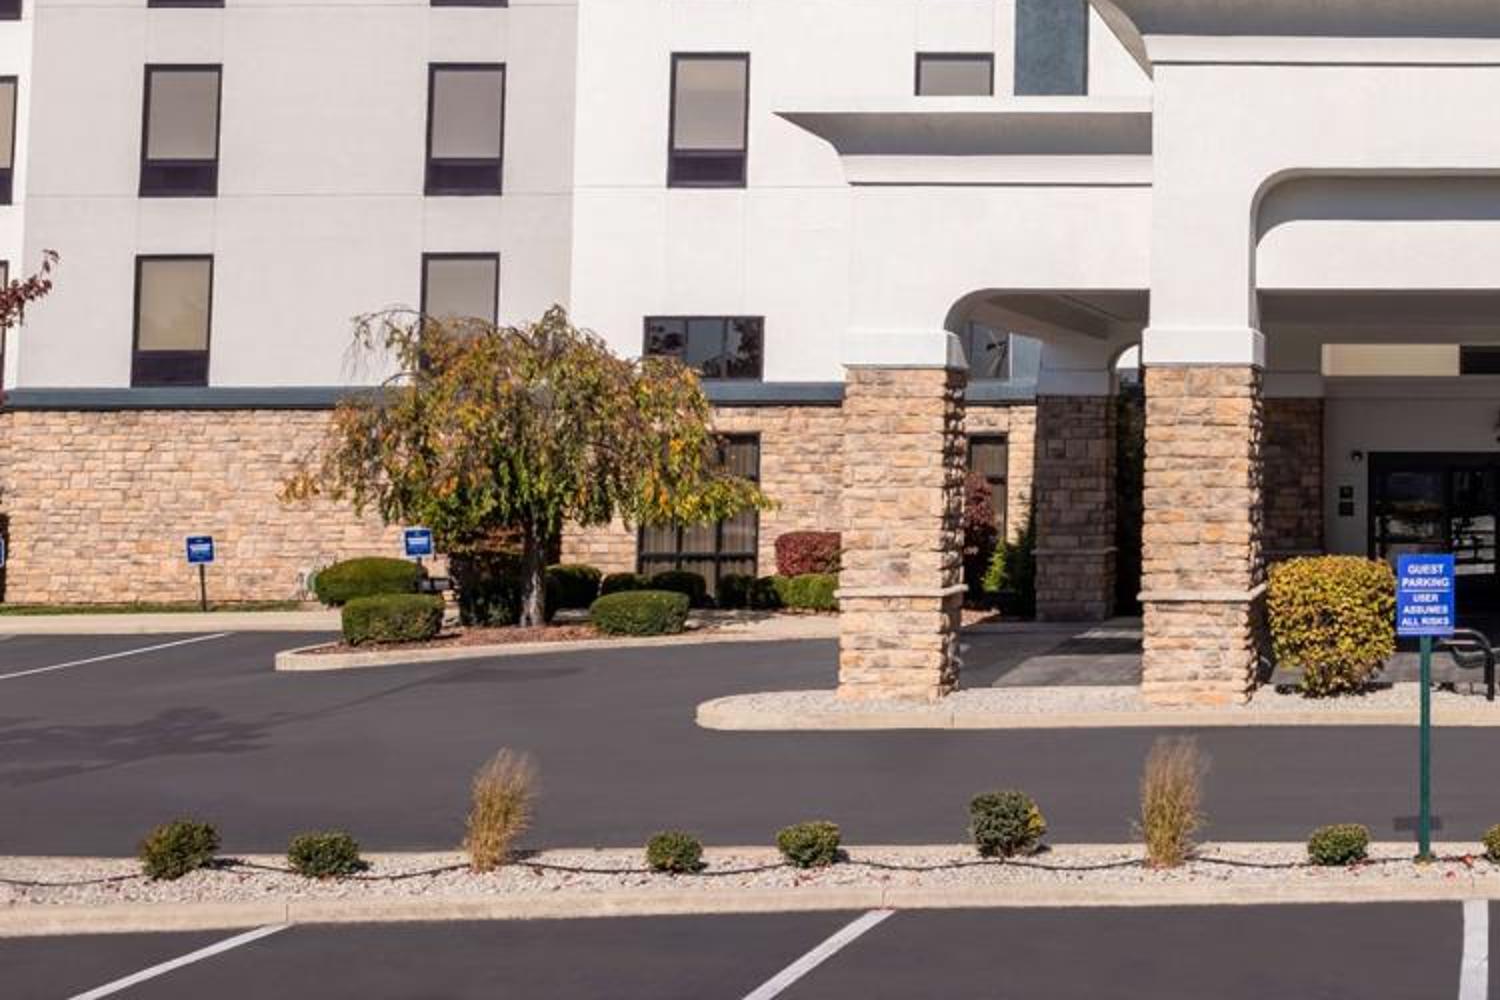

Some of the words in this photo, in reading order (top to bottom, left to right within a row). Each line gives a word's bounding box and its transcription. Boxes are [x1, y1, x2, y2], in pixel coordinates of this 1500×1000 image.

[1407, 563, 1444, 575] GUEST
[1401, 577, 1450, 588] PARKING
[1412, 593, 1439, 603] USER
[1403, 605, 1449, 615] ASSUMES
[1401, 616, 1419, 626] ALL
[1421, 616, 1450, 626] RISKS
